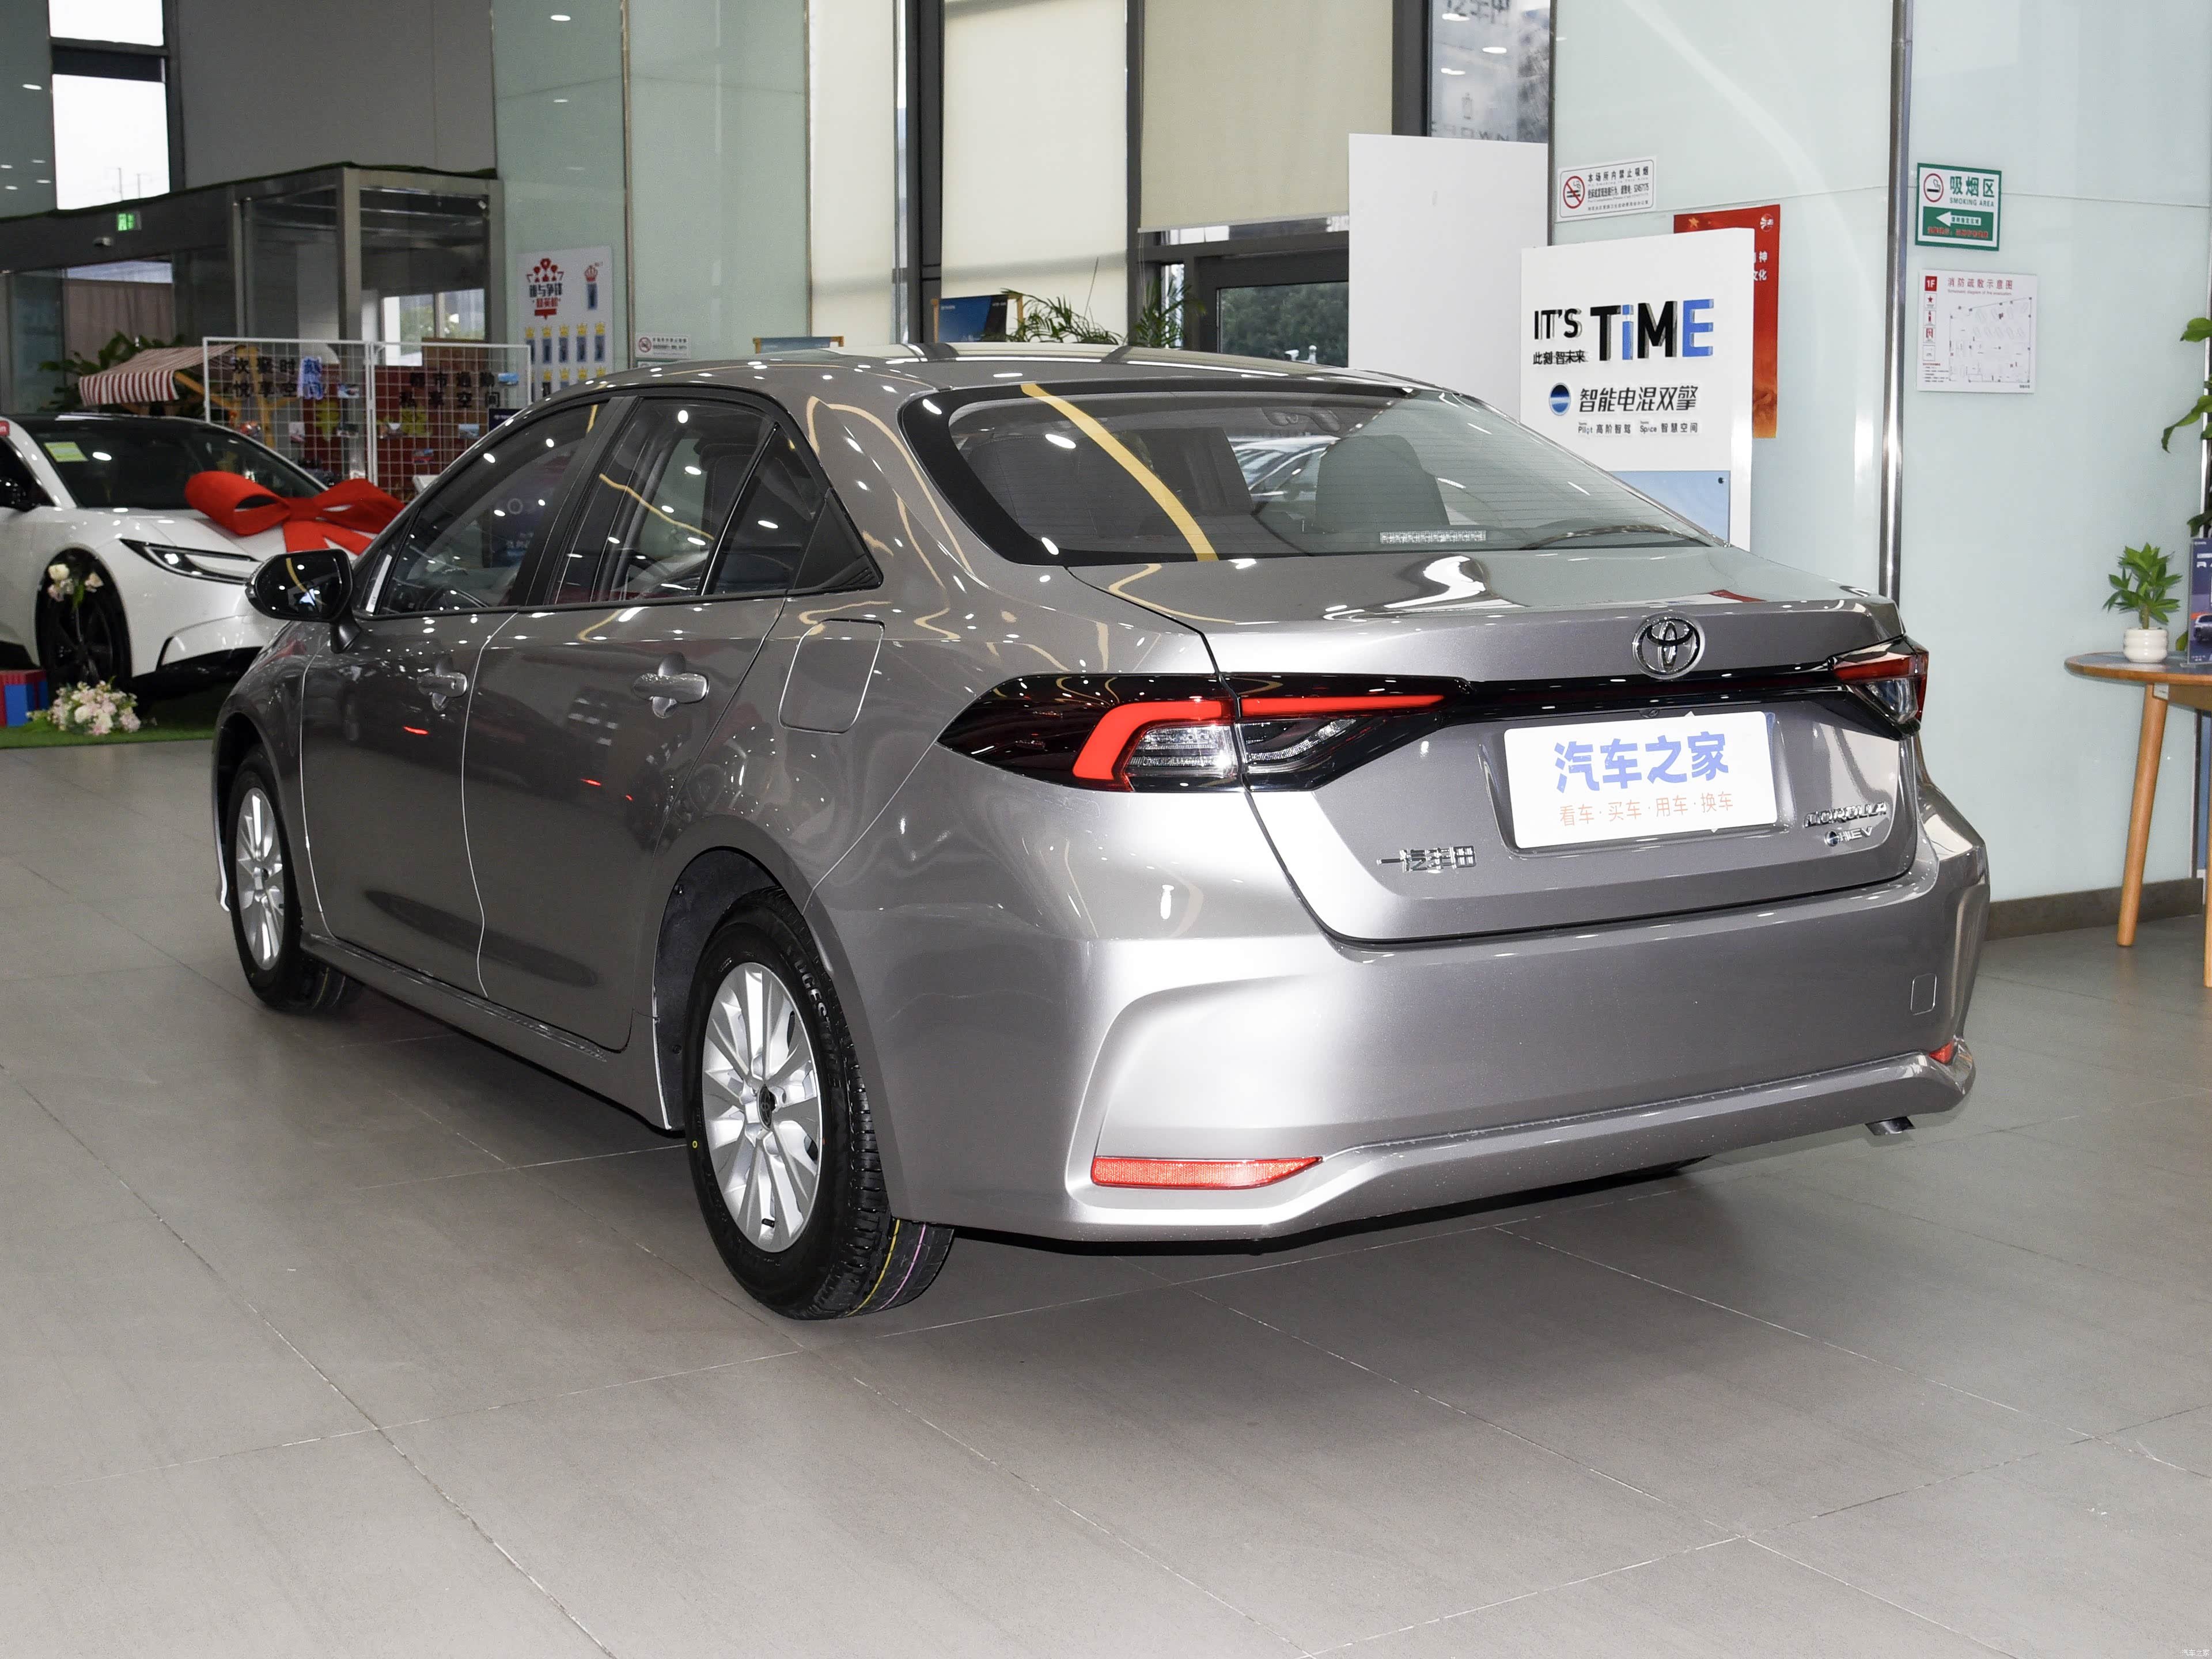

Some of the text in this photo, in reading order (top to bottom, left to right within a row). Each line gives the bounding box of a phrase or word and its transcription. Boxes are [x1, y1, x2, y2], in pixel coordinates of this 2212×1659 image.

[1950, 176, 1994, 198] 吸烟区
[1949, 197, 1977, 206] SMOKING
[1927, 279, 1936, 288] 1F
[1948, 277, 2013, 290] 消防疏散示意图
[1534, 308, 1582, 340] IT'S
[1579, 385, 1698, 412] 智能电混双擎
[1596, 424, 1631, 434] 高阶智驾
[1661, 423, 1698, 433] 智慧空间
[1554, 731, 1728, 793] 汽车之家
